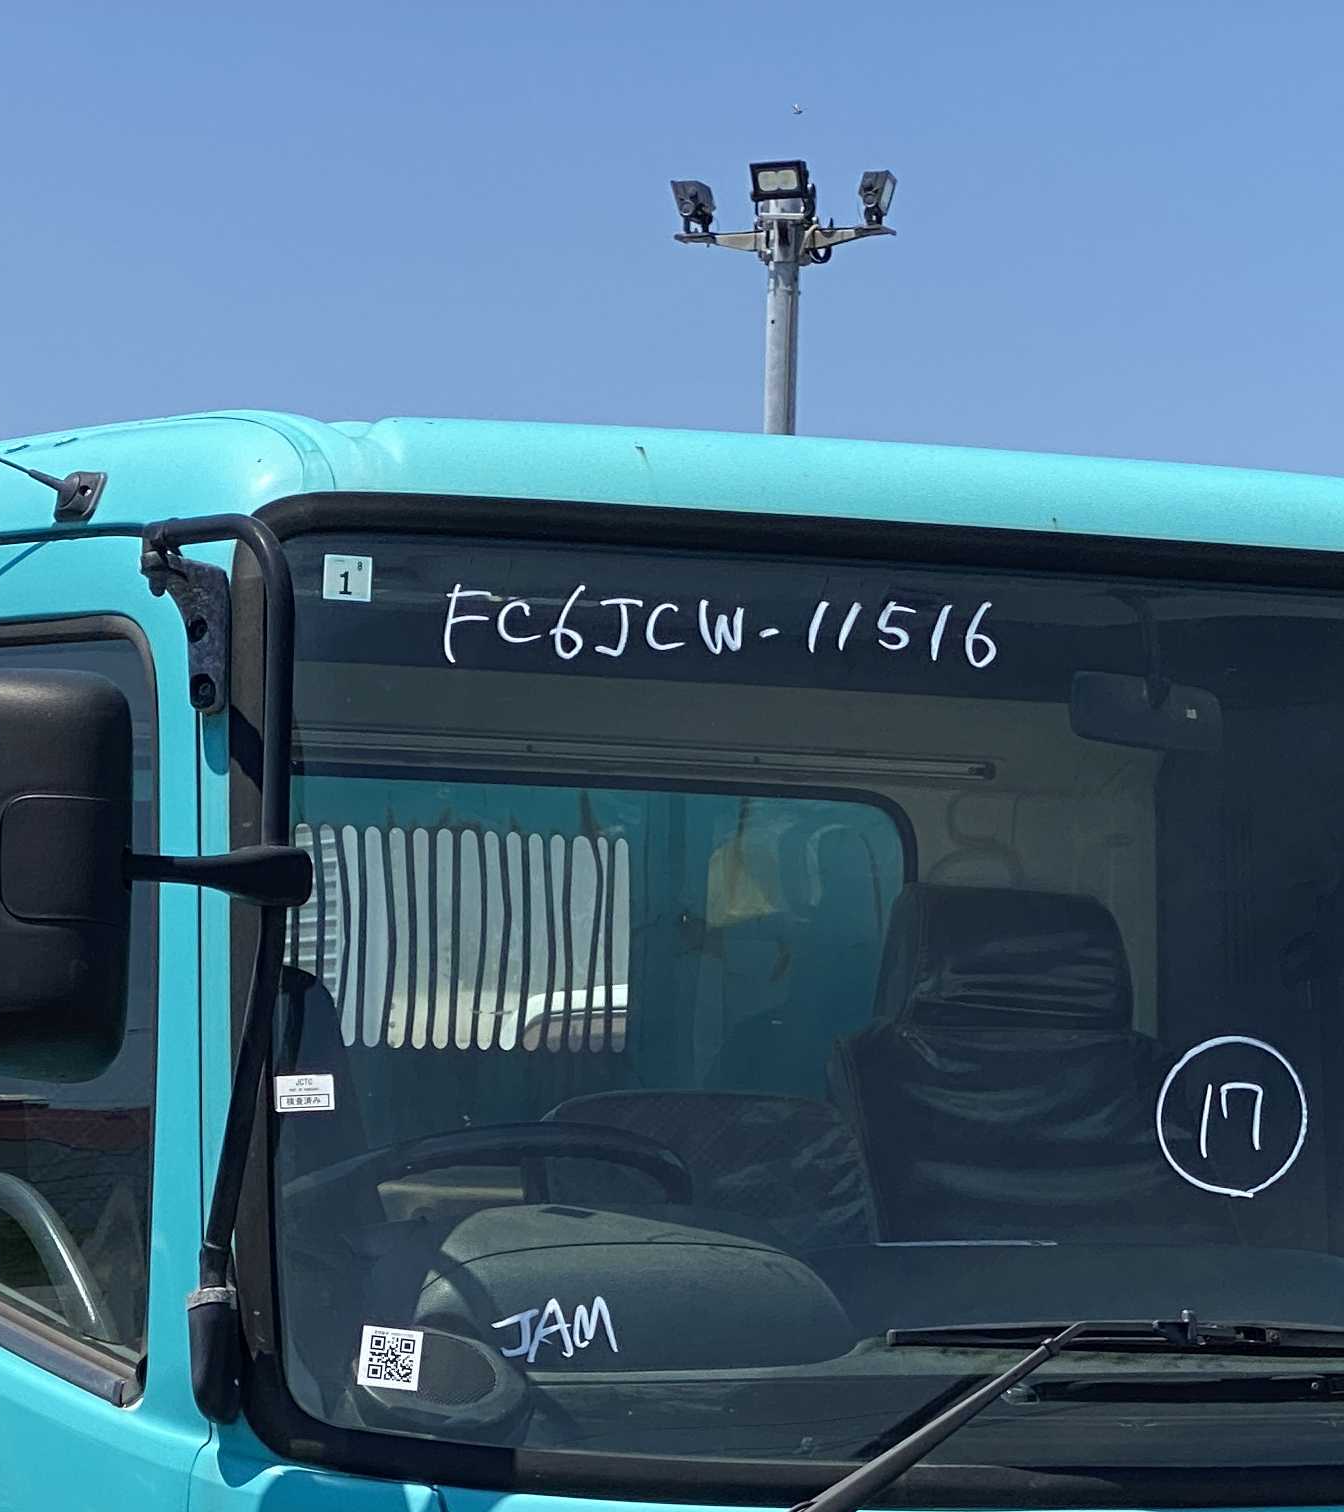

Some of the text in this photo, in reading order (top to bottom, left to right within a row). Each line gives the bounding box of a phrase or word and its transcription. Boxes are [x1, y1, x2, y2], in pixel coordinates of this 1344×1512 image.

[339, 570, 353, 595] 1
[442, 582, 999, 669] FC6JCW-11516
[491, 1295, 619, 1363] JAM
